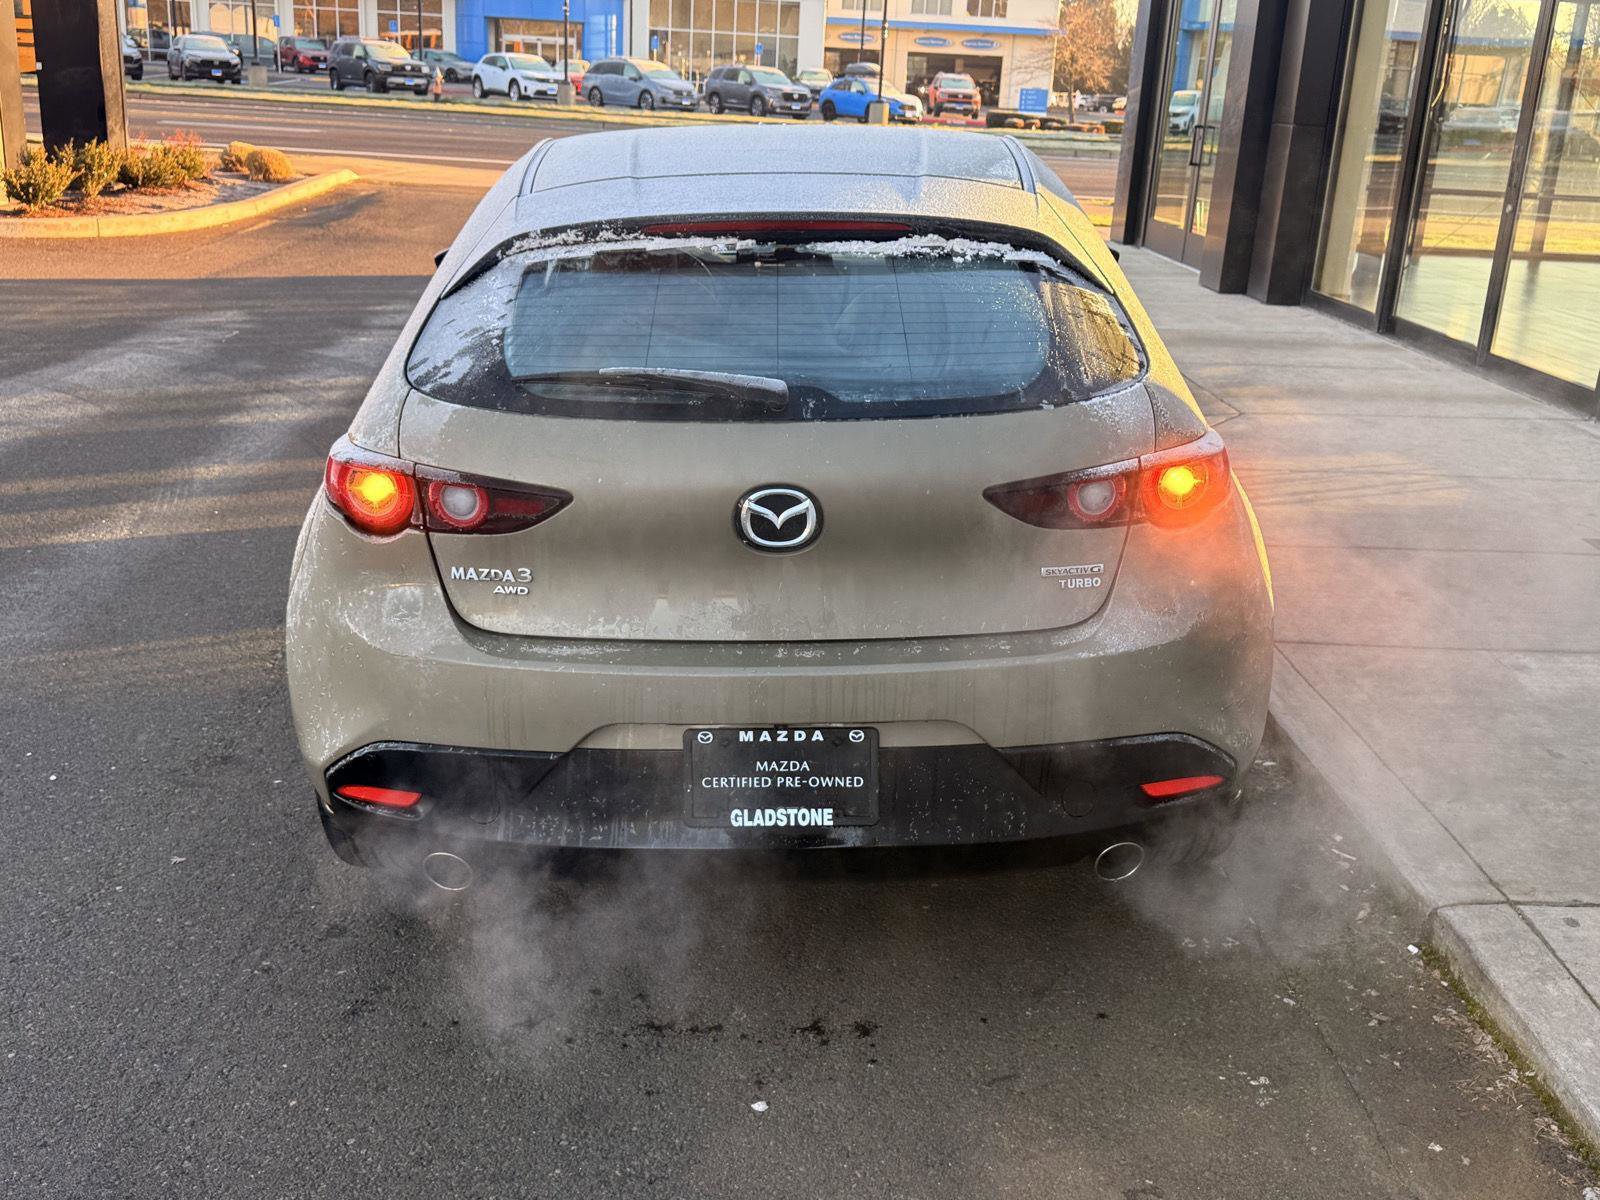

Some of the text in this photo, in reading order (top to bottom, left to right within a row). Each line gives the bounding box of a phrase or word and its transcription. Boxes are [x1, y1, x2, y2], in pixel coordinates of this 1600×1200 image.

[1059, 577, 1101, 588] TURBO
[493, 585, 529, 595] AWD
[739, 730, 824, 742] MAZDA
[756, 761, 810, 771] MAZDA
[702, 776, 864, 787] CERTIFIED PRE-OWNED
[730, 808, 834, 827] GLADSTONE
